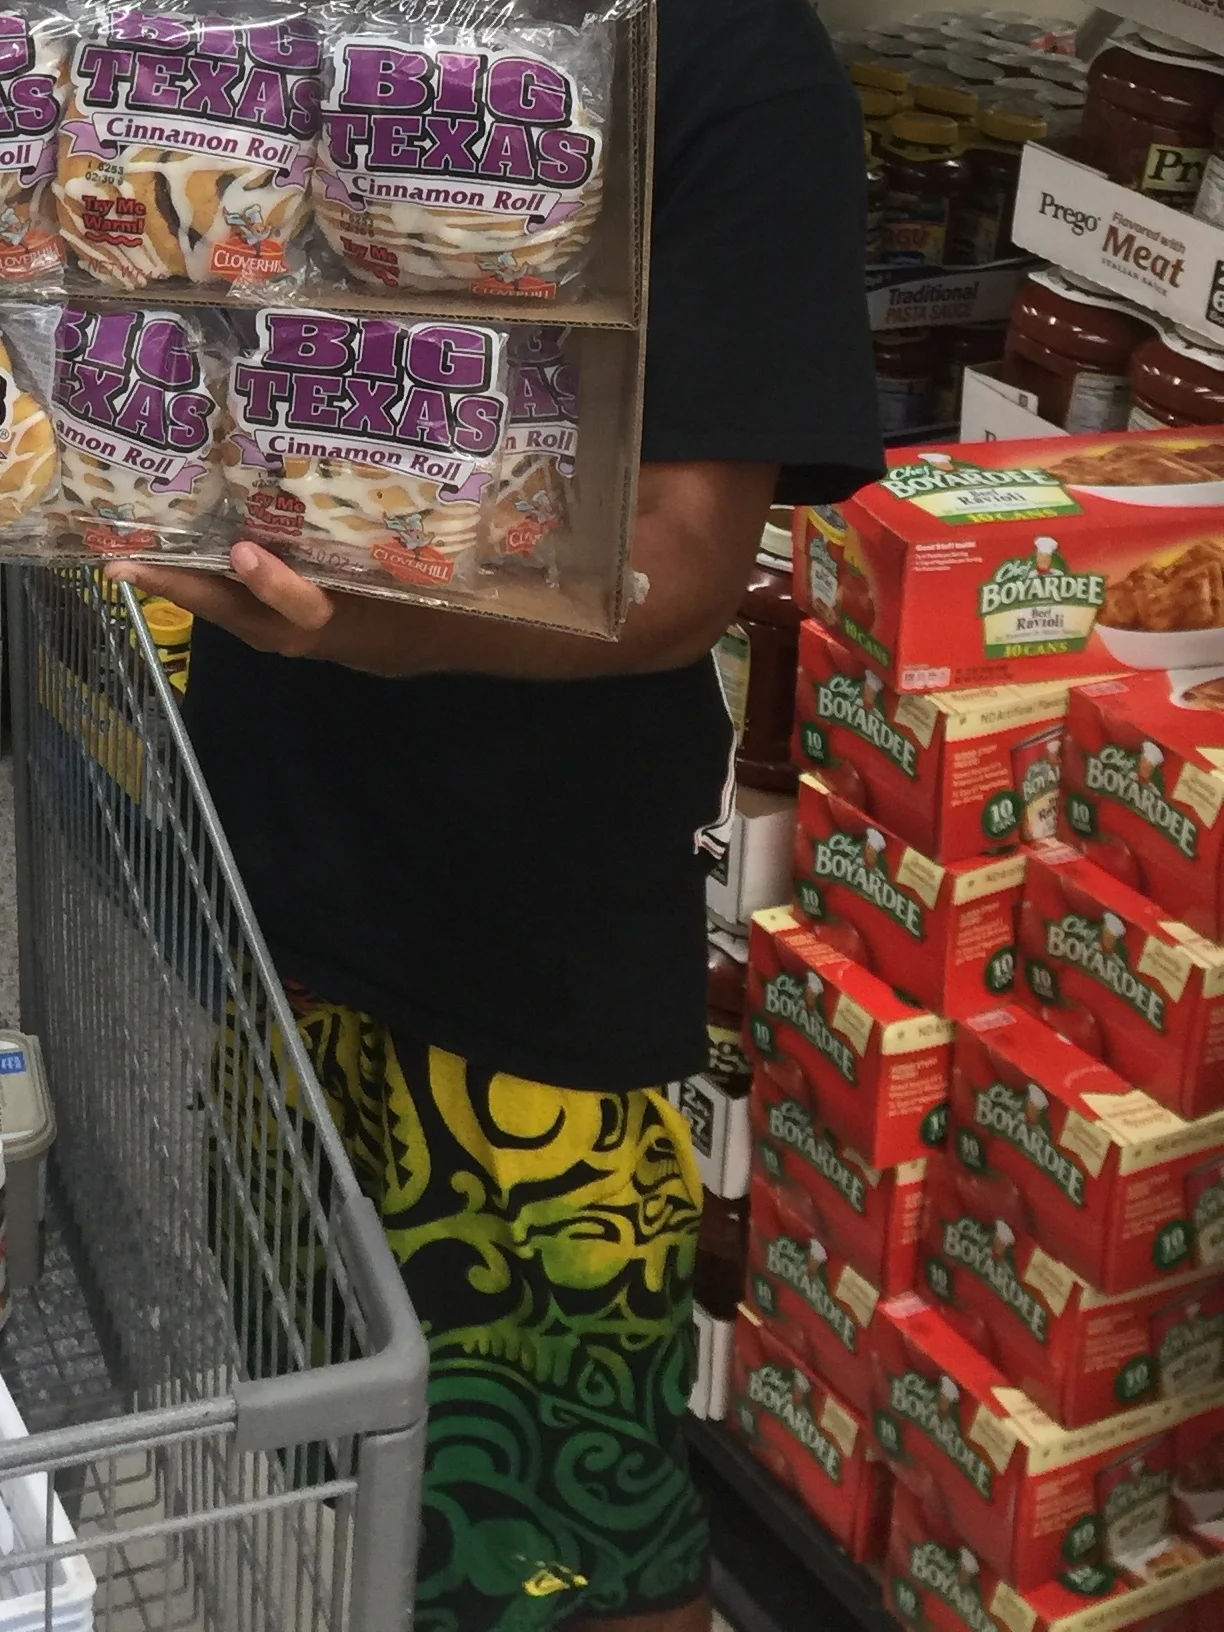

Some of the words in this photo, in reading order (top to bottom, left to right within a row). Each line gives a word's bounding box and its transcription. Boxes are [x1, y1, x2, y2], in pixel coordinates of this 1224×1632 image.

[80, 48, 323, 138] TEXAS
[343, 46, 573, 125] BIG
[105, 117, 238, 156] Cinnamon
[244, 141, 294, 168] Roll
[323, 112, 595, 188] TEXAS
[81, 195, 112, 220] Try
[119, 198, 147, 217] Me
[351, 174, 487, 210] Cinnamon
[493, 187, 546, 214] Roll
[82, 213, 146, 236] Warm!
[1038, 190, 1100, 236] Prego
[1112, 211, 1162, 244] Flavored
[1160, 233, 1187, 254] with
[1101, 223, 1186, 289] Meat
[885, 306, 930, 325] PASTA
[931, 302, 974, 321] SAUCE
[888, 280, 979, 308] Traditional
[262, 313, 490, 392] BIG
[235, 367, 506, 456] TEXAS
[121, 446, 176, 477] Roll
[267, 432, 403, 470] Cinnamon
[408, 453, 461, 483] Roll
[882, 467, 1051, 500] BOYARDEE
[957, 490, 1027, 508] Ravioli
[992, 508, 1059, 522] CANS
[372, 546, 453, 584] CLOVERHILL
[995, 560, 1032, 584] Chef
[981, 574, 1104, 614] BOYARDEE
[1030, 608, 1052, 619] Beef
[1015, 614, 1065, 632] Ravioli
[1021, 641, 1068, 656] CANS
[817, 686, 917, 777] BOYARDEE
[990, 799, 1015, 824] 10
[1086, 755, 1197, 858] BOYARDEE
[828, 831, 866, 860] Chef
[816, 846, 923, 938] BOYARDEE
[992, 955, 1014, 979] 10
[1047, 927, 1165, 1032] BOYARDEE
[764, 989, 855, 1084] BOYARDEE
[977, 1098, 1084, 1208] BOYARDEE
